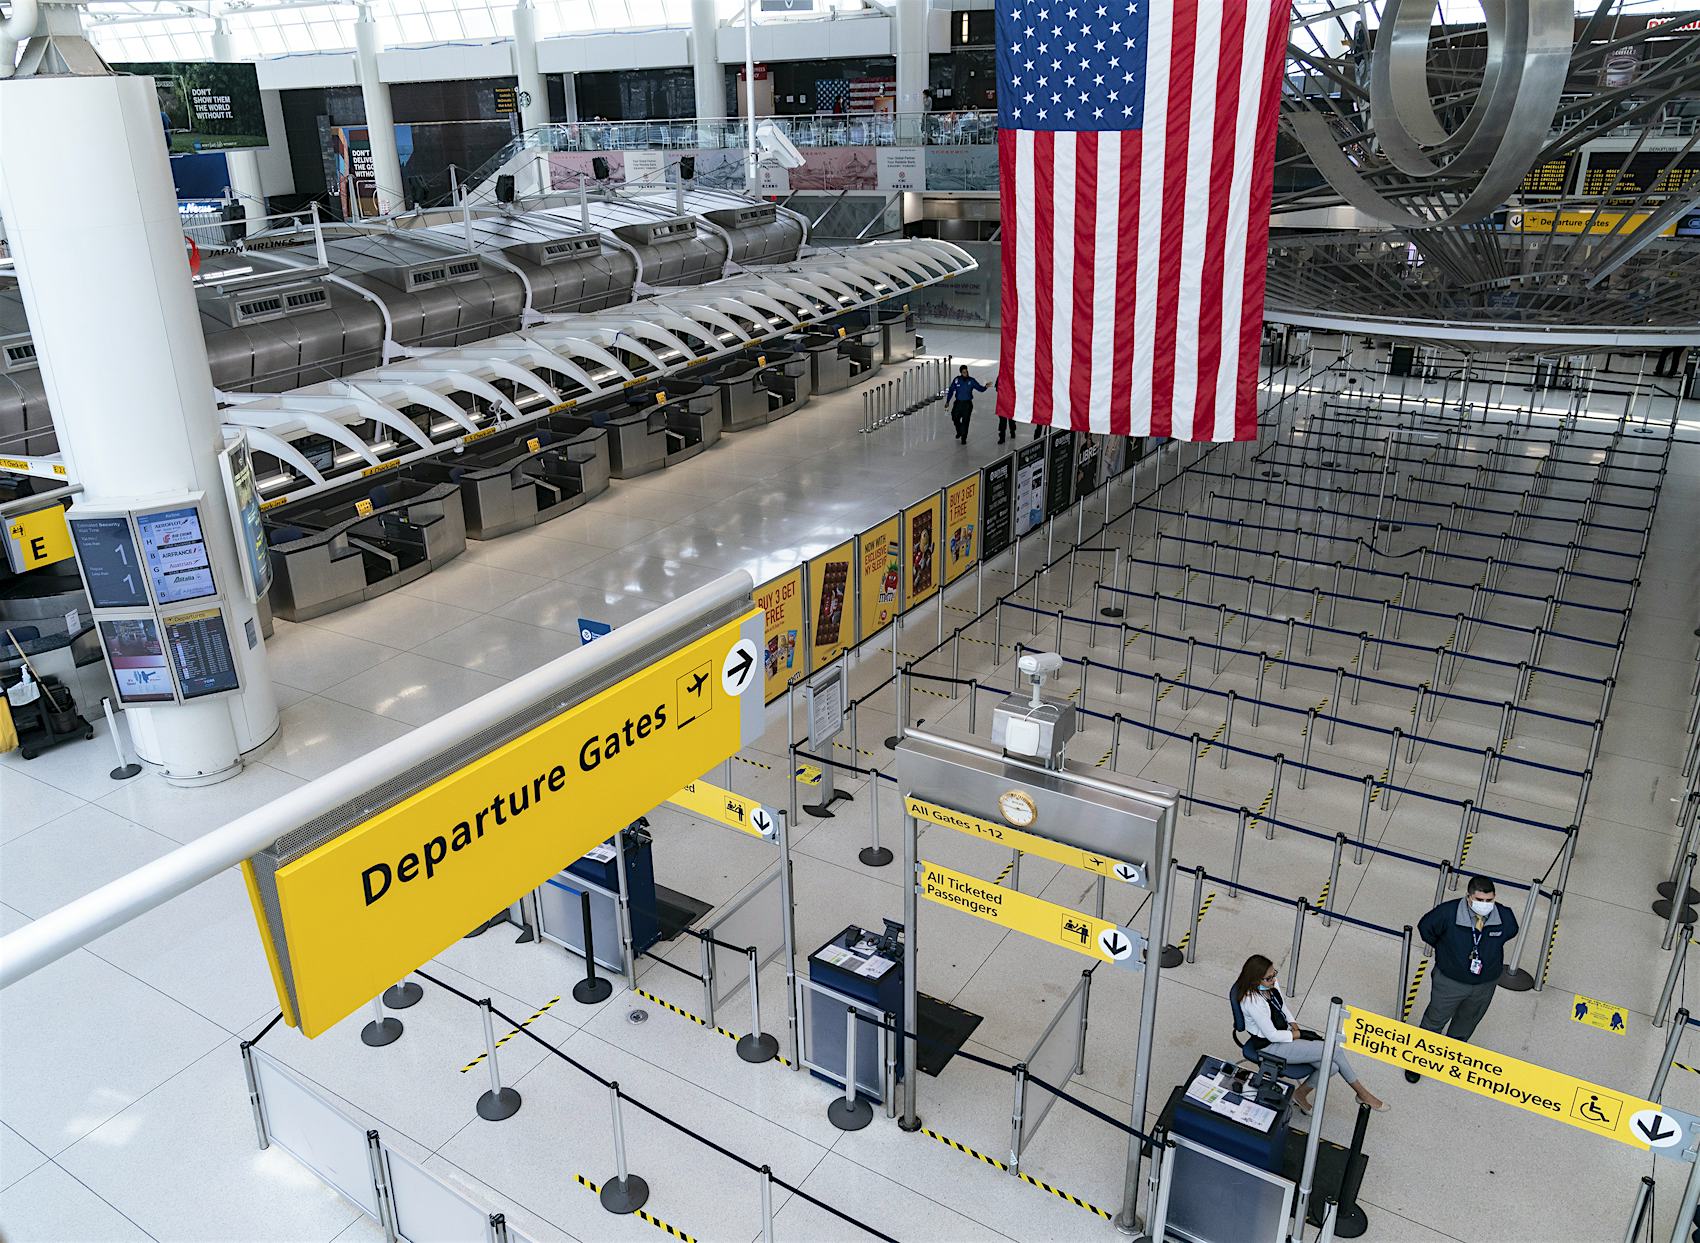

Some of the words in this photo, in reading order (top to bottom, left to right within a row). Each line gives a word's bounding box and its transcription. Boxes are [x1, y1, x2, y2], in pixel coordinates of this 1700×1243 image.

[208, 104, 231, 112] WORLD
[213, 96, 231, 104] THEM
[196, 112, 225, 120] WITHOUT
[1541, 218, 1583, 228] Dearture
[1585, 220, 1609, 228] Gtes
[208, 246, 244, 258] JAPAN
[246, 238, 296, 252] AIRLINES
[1079, 442, 1100, 465] LIBRE
[950, 492, 960, 508] BUY
[961, 489, 965, 502] 3
[966, 484, 975, 499] GET
[950, 509, 953, 521] 1
[954, 502, 967, 517] FREE
[30, 537, 48, 560] E
[115, 543, 127, 565] 1
[162, 549, 192, 558] AIRFRANCE
[865, 541, 875, 553] NOW
[876, 534, 886, 546] WITH
[865, 544, 887, 565] EXCLUSIVE
[865, 565, 871, 576] NY
[871, 556, 887, 573] SLEEVE
[123, 574, 135, 594] 1
[758, 592, 773, 610] BUY
[775, 589, 779, 604] 3
[782, 581, 796, 600] GET
[175, 612, 205, 622] Departures
[766, 603, 785, 627] FREE
[362, 765, 566, 907] Departure
[579, 704, 667, 772] Gates
[911, 804, 929, 816] All
[932, 811, 971, 829] Gates
[975, 824, 1004, 840] 1-12
[927, 871, 944, 884] All
[947, 877, 1002, 905] Ticketed
[927, 884, 998, 917] Passengers
[1355, 1018, 1411, 1046] Special
[1414, 1039, 1503, 1076] Assistance
[1352, 1033, 1397, 1058] Flight
[1402, 1049, 1445, 1072] Crew
[1449, 1065, 1461, 1079] &
[1466, 1071, 1562, 1112] Employees
